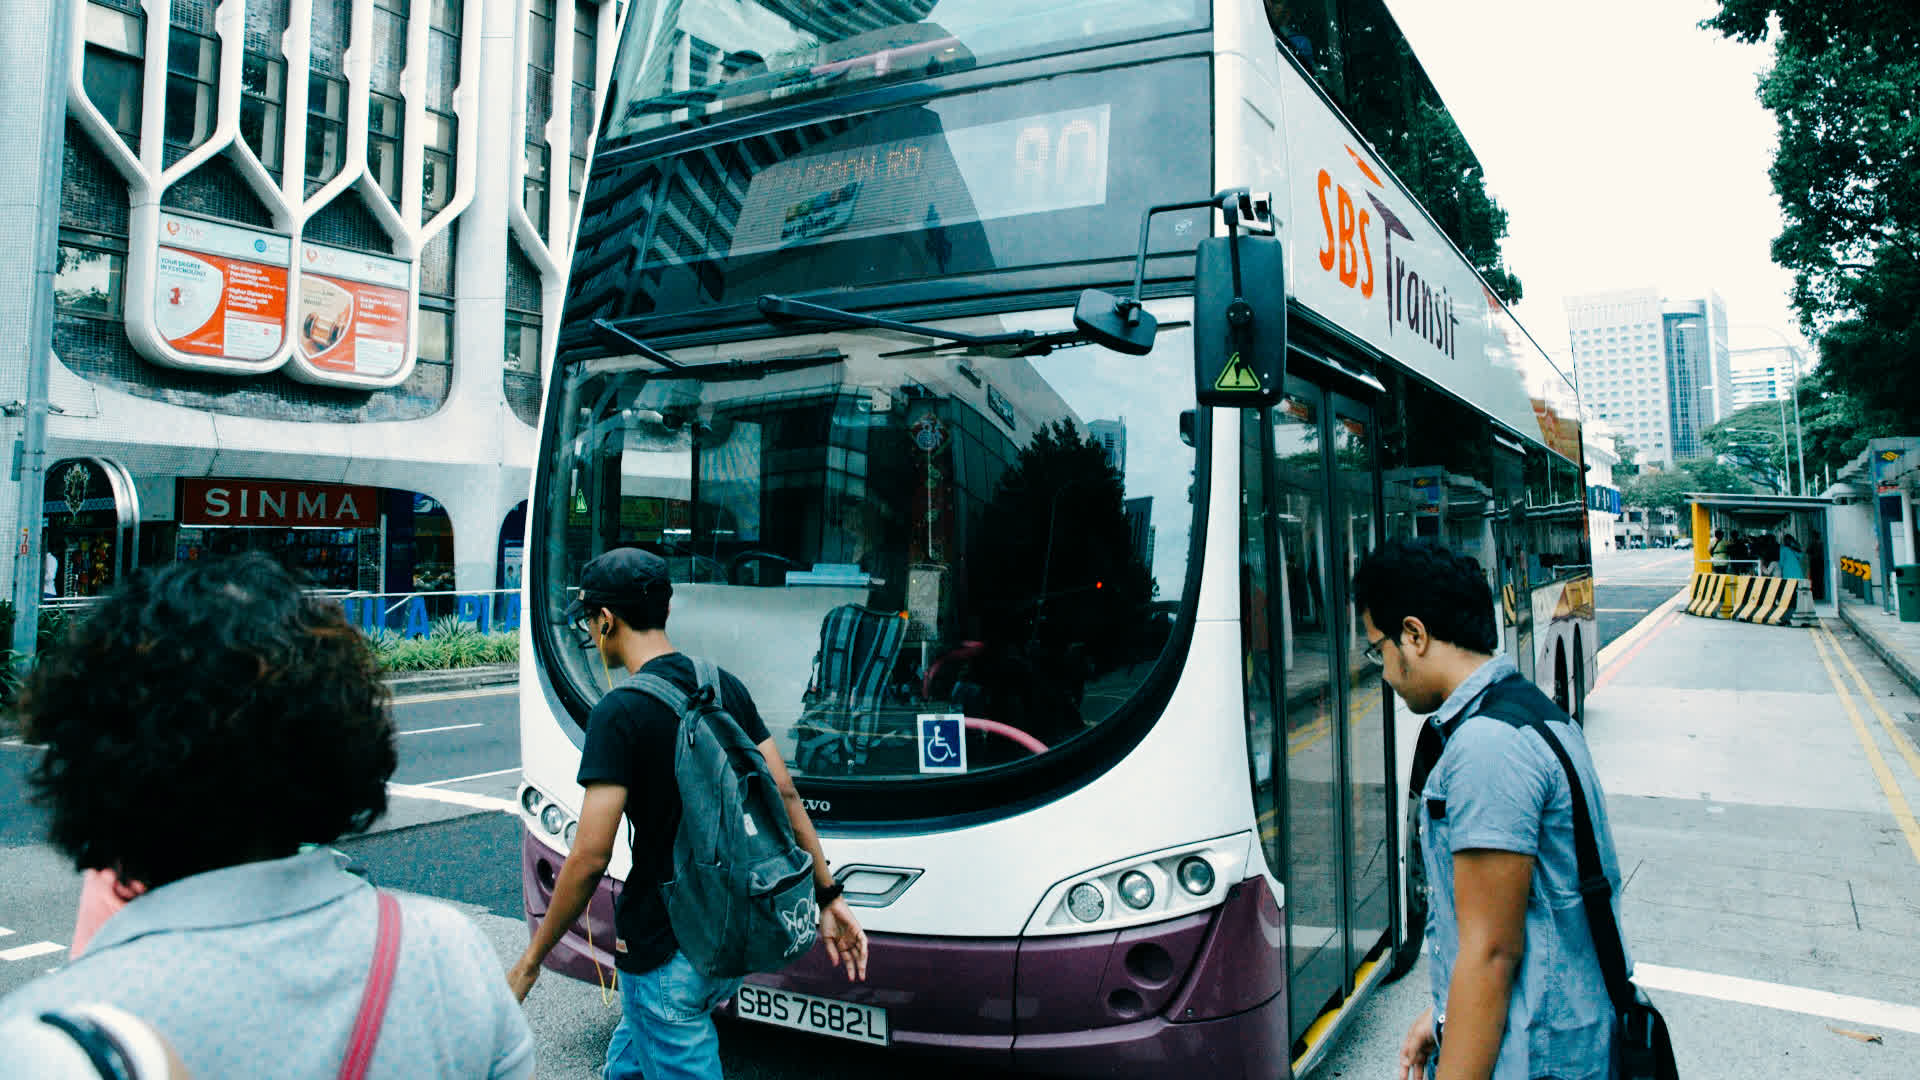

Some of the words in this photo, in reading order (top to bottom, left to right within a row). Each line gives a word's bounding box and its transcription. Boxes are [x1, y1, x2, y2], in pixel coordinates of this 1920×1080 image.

[1317, 168, 1374, 301] SBS
[1366, 189, 1460, 361] Transit
[205, 487, 360, 520] SINMA
[739, 986, 885, 1041] SBS7682L
